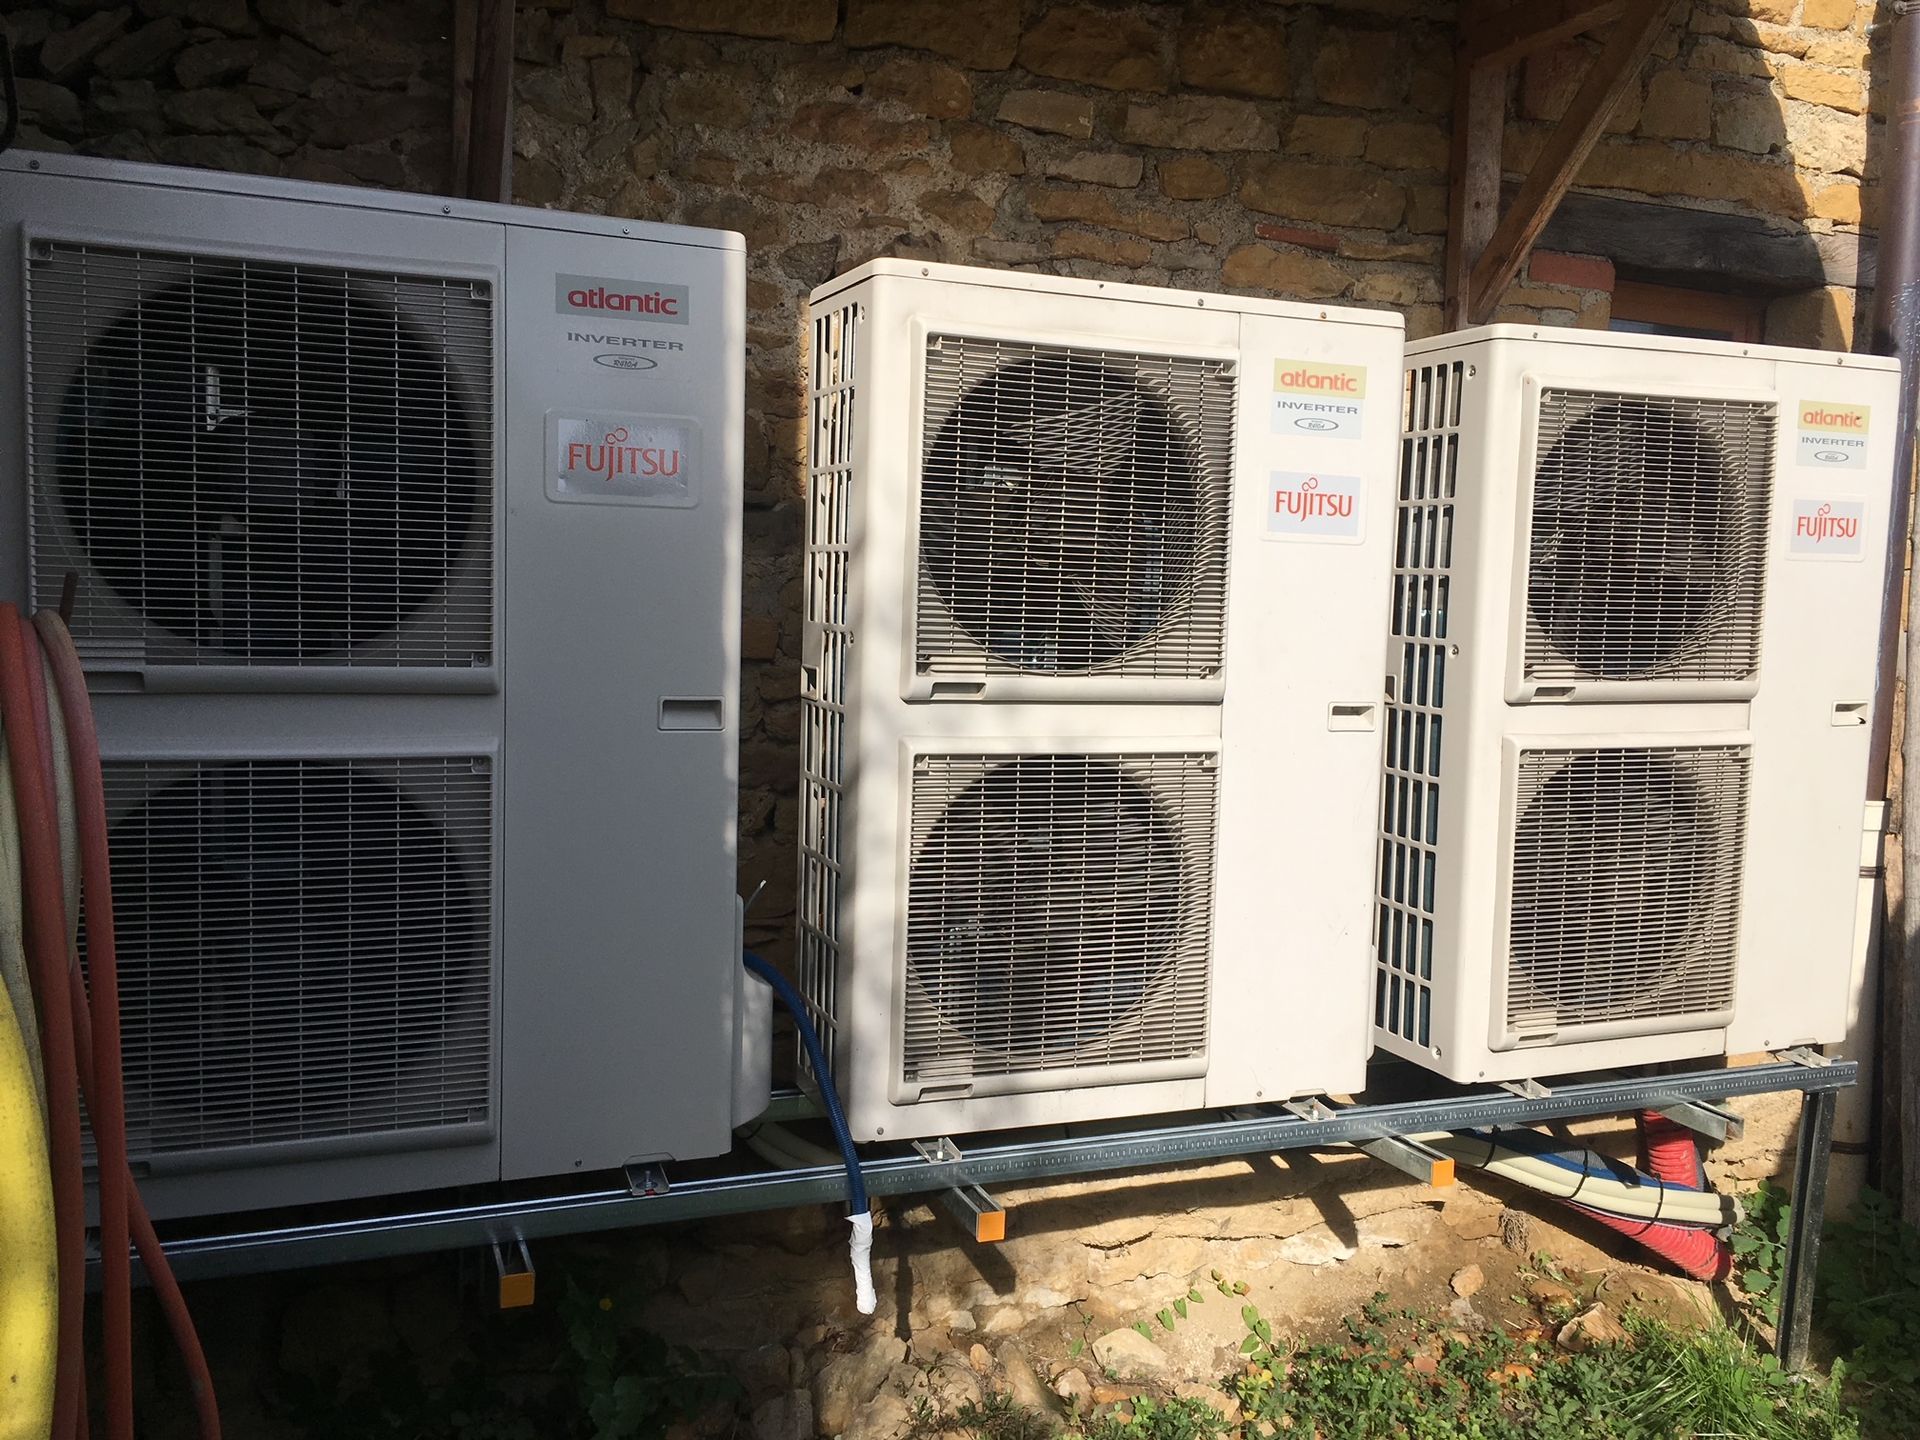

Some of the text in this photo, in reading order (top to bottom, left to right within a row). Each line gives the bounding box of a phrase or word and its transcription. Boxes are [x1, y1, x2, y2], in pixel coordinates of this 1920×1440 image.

[568, 287, 678, 315] atlantic
[567, 332, 684, 351] INVERTER
[1280, 369, 1358, 392] atlantic
[1277, 401, 1358, 414] INVERTER
[1803, 409, 1863, 428] atlantic
[1802, 437, 1865, 447] INVERTER
[568, 428, 680, 481] FUJITSU
[1275, 478, 1353, 521] FUJITSU
[1797, 504, 1857, 543] FUJITSU
